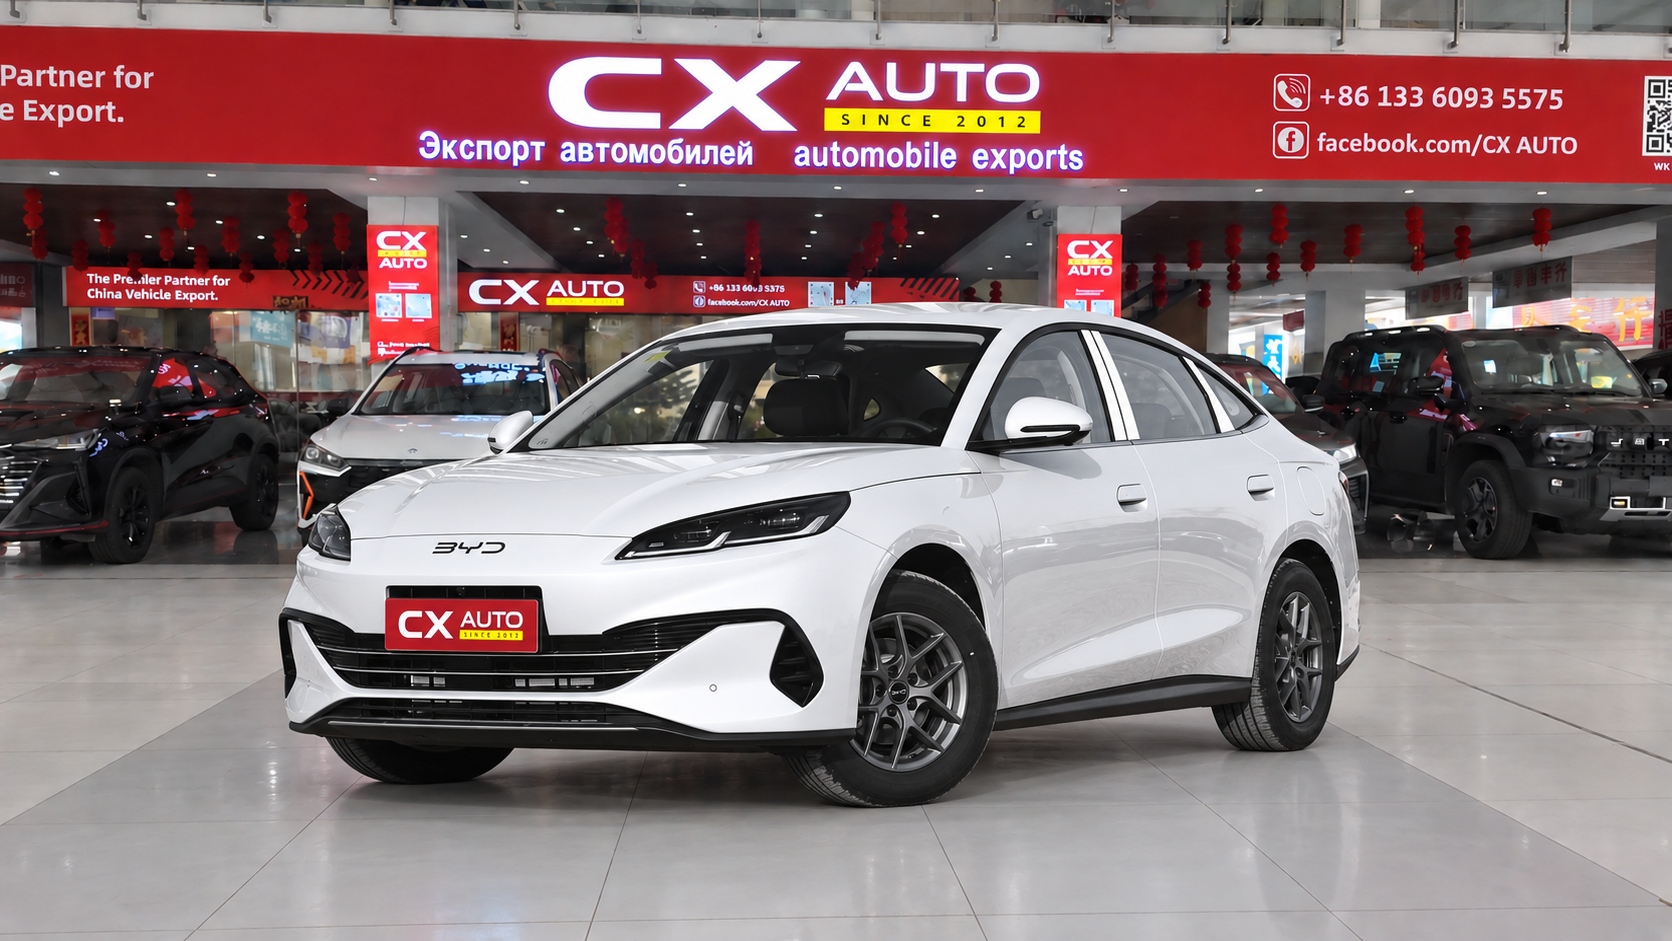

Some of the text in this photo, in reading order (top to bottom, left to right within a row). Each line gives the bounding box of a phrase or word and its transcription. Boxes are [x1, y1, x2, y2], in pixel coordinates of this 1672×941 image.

[1, 64, 154, 89] Partner for
[548, 56, 1040, 131] CX AUTO
[1320, 86, 1564, 110] +86 133 6093 5575
[23, 100, 124, 128] Export.
[841, 114, 1026, 128] SINCE 2012
[418, 130, 753, 167] Экспорт автомобилей
[1317, 133, 1578, 156] facebook.com/CX AUTO
[794, 141, 1084, 174] automobile exports
[376, 230, 427, 250] CX
[1067, 240, 1113, 259] CX
[379, 257, 428, 269] AUTO
[1067, 265, 1113, 276] AUTO
[87, 273, 110, 284] The
[164, 275, 210, 286] Partner
[212, 275, 231, 286] for
[87, 288, 218, 303] China Vehicle Export.
[468, 279, 625, 305] CX AUTO
[769, 299, 790, 307] AUTO
[432, 541, 506, 555] BYD
[398, 610, 524, 639] CX AUTO
